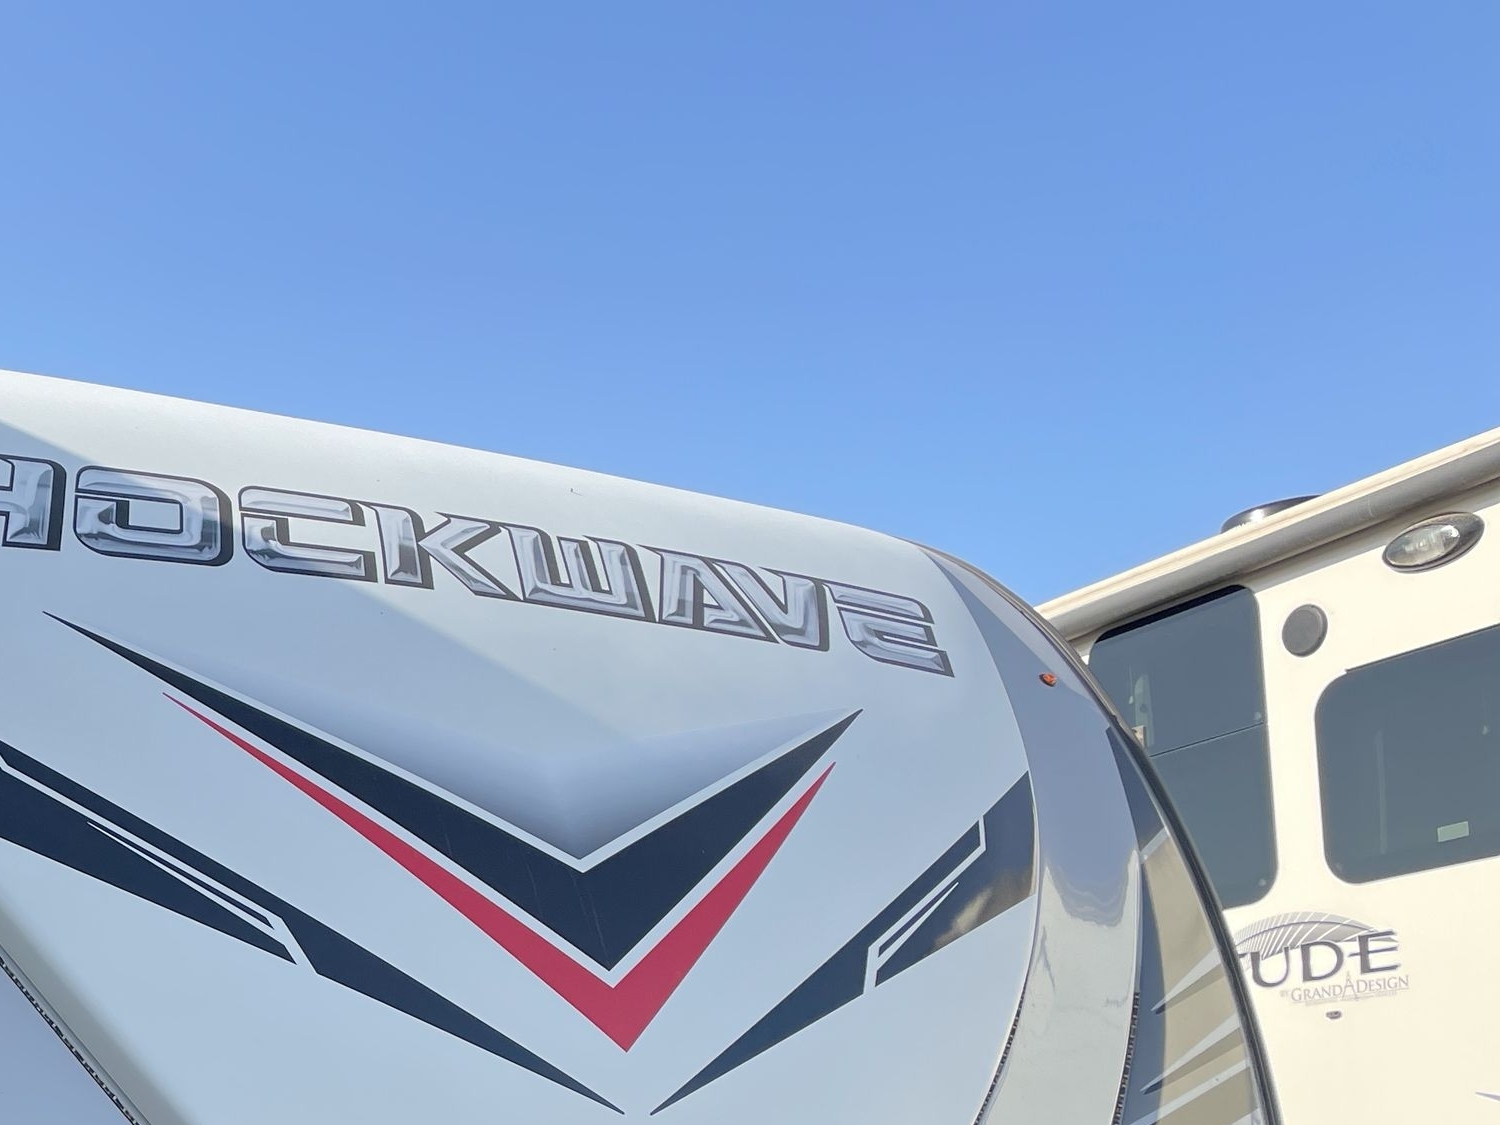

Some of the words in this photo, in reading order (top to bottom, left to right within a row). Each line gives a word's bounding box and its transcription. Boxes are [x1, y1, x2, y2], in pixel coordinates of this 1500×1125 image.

[1239, 930, 1400, 988] UDE
[1291, 984, 1343, 1002] GRAND
[1356, 975, 1409, 994] DESIGN
